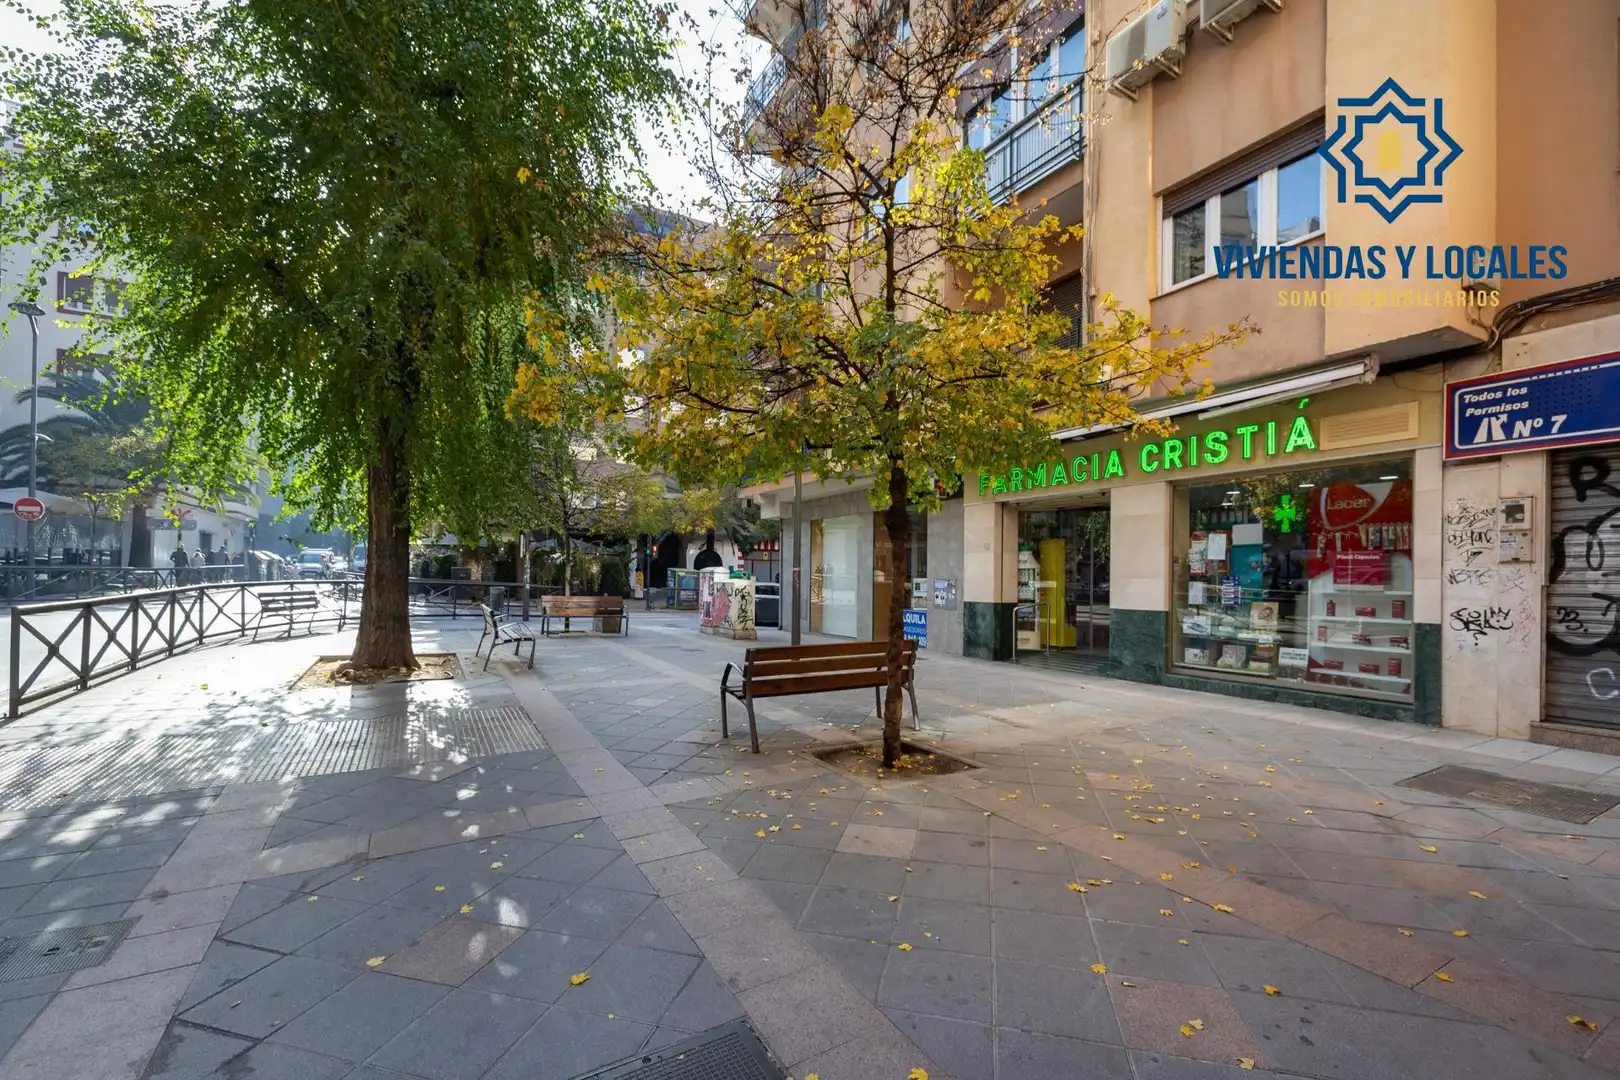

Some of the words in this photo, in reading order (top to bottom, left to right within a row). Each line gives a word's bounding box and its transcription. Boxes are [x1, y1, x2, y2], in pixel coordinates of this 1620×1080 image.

[1463, 390, 1503, 404] Todos
[1506, 386, 1528, 398] los
[1465, 400, 1530, 417] Permisos
[1550, 414, 1568, 434] 7
[979, 447, 1124, 496] FARMACIA
[1139, 398, 1317, 474] CRISTIÁ
[1327, 497, 1371, 510] Lacer
[903, 612, 926, 624] LQUILA
